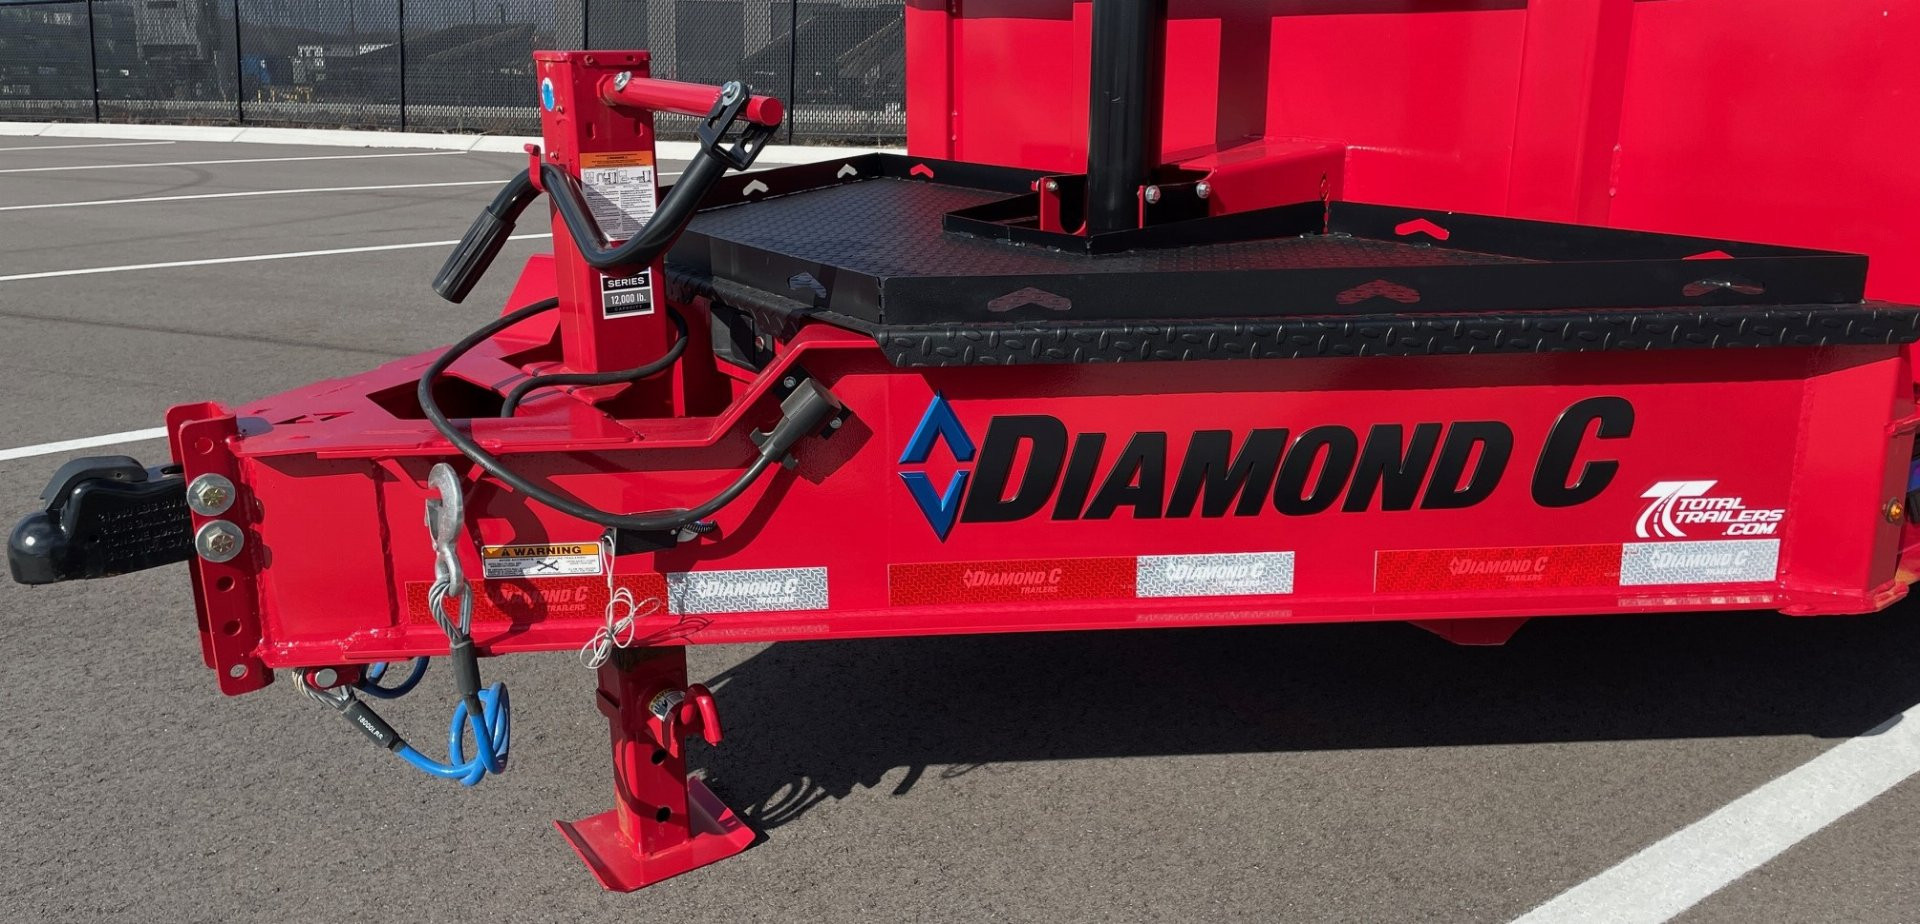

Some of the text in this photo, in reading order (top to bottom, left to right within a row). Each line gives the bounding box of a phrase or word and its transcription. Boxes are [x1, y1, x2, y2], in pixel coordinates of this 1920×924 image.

[607, 276, 645, 288] SERIES
[610, 293, 635, 306] 12,000
[959, 395, 1635, 524] DIAMOND C
[1678, 497, 1746, 511] TOTAL
[1674, 508, 1787, 524] TRAILERS
[1721, 522, 1778, 536] .COM
[514, 545, 582, 557] WARNING
[1657, 551, 1733, 568] DIAMOND
[1734, 550, 1748, 566] C
[1171, 563, 1248, 581] DIAMOND
[1457, 556, 1548, 575] DIAMOND C
[972, 567, 1063, 587] DIAMOND C
[574, 585, 588, 602] C
[705, 577, 799, 598] DIAMOND C
[1020, 585, 1059, 595] TRAILERS
